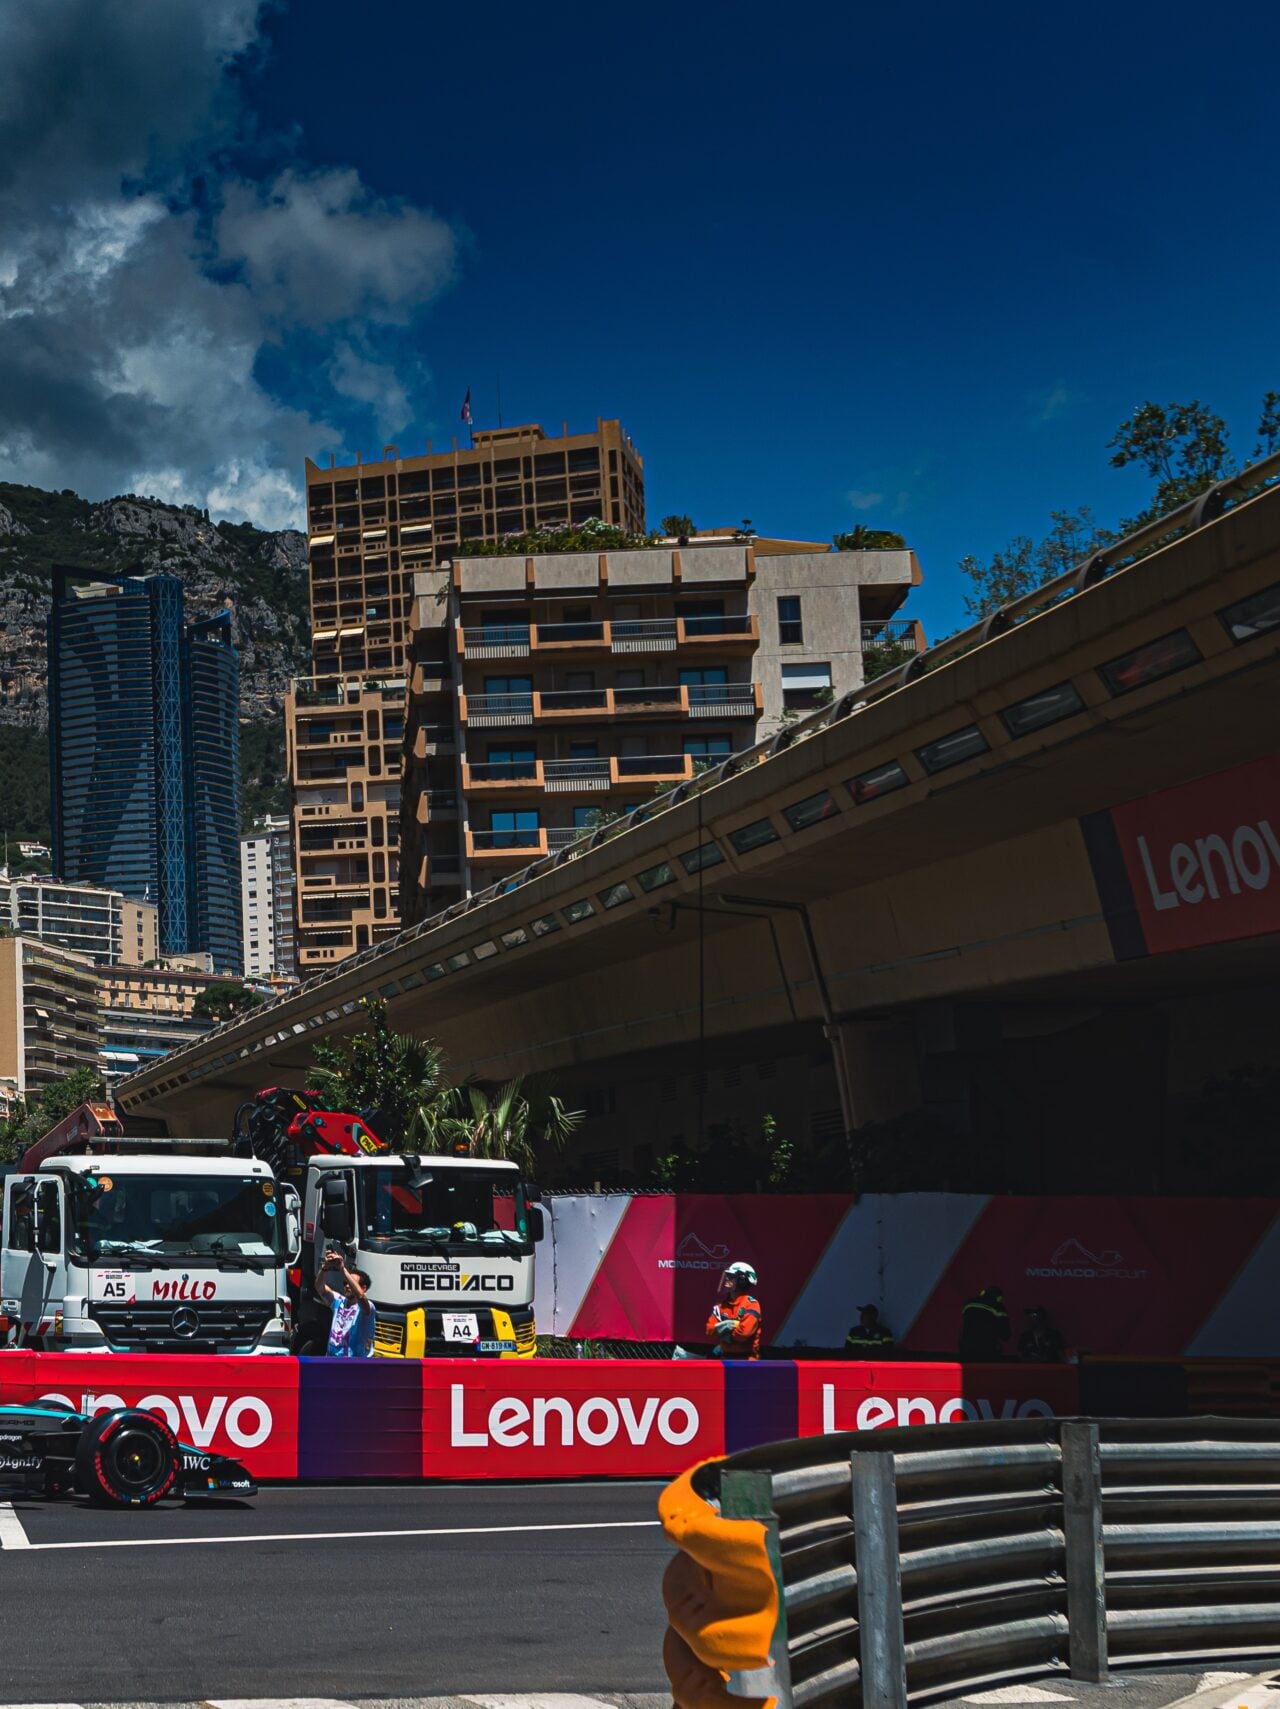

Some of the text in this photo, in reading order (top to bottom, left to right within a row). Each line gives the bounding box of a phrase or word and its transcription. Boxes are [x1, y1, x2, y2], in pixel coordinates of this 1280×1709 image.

[103, 1283, 126, 1298] A5
[152, 1280, 217, 1301] MILLO
[452, 1325, 472, 1337] A4
[451, 1384, 699, 1447] Lenovo
[183, 1455, 211, 1470] IWC
